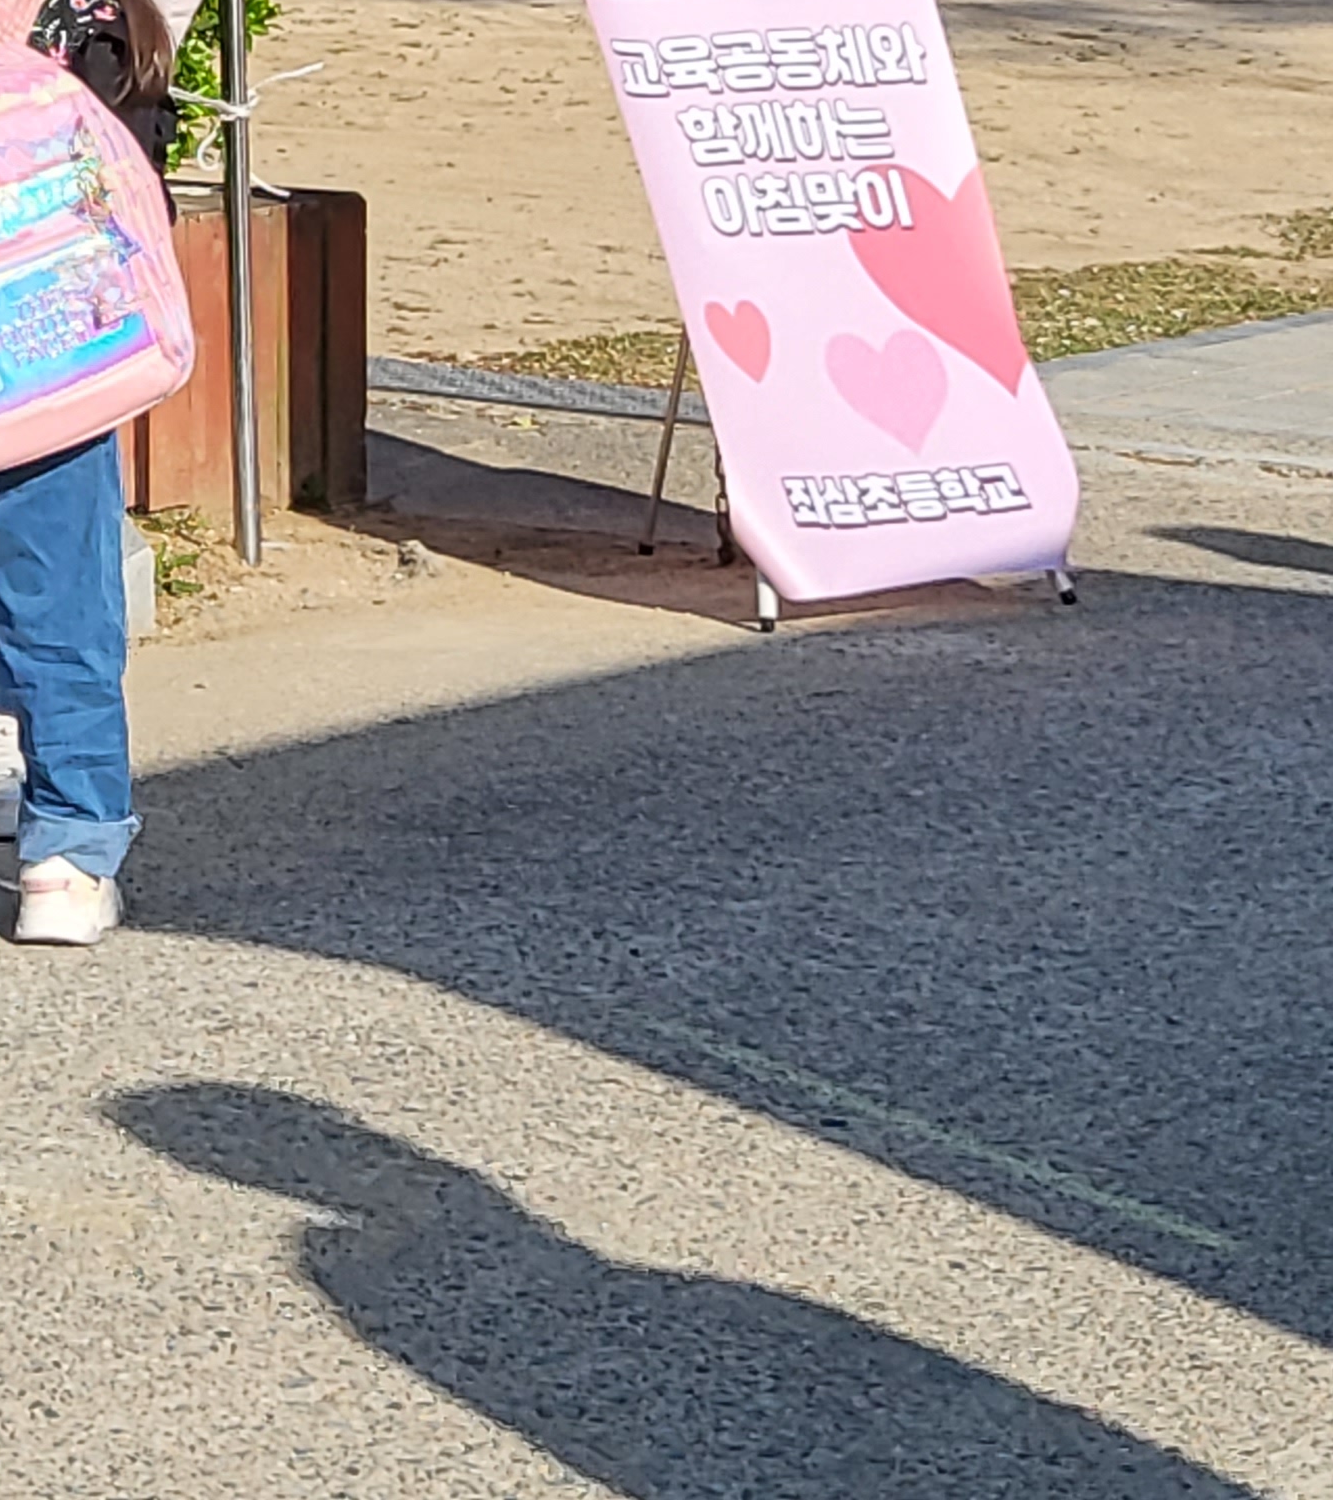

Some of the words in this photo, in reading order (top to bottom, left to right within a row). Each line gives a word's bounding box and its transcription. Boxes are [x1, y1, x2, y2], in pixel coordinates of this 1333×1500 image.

[612, 24, 927, 98] 교육공동체와
[676, 100, 895, 166] 함께하는
[702, 169, 914, 236] 아침맞이
[782, 463, 1033, 528] 좌삼초등학교
